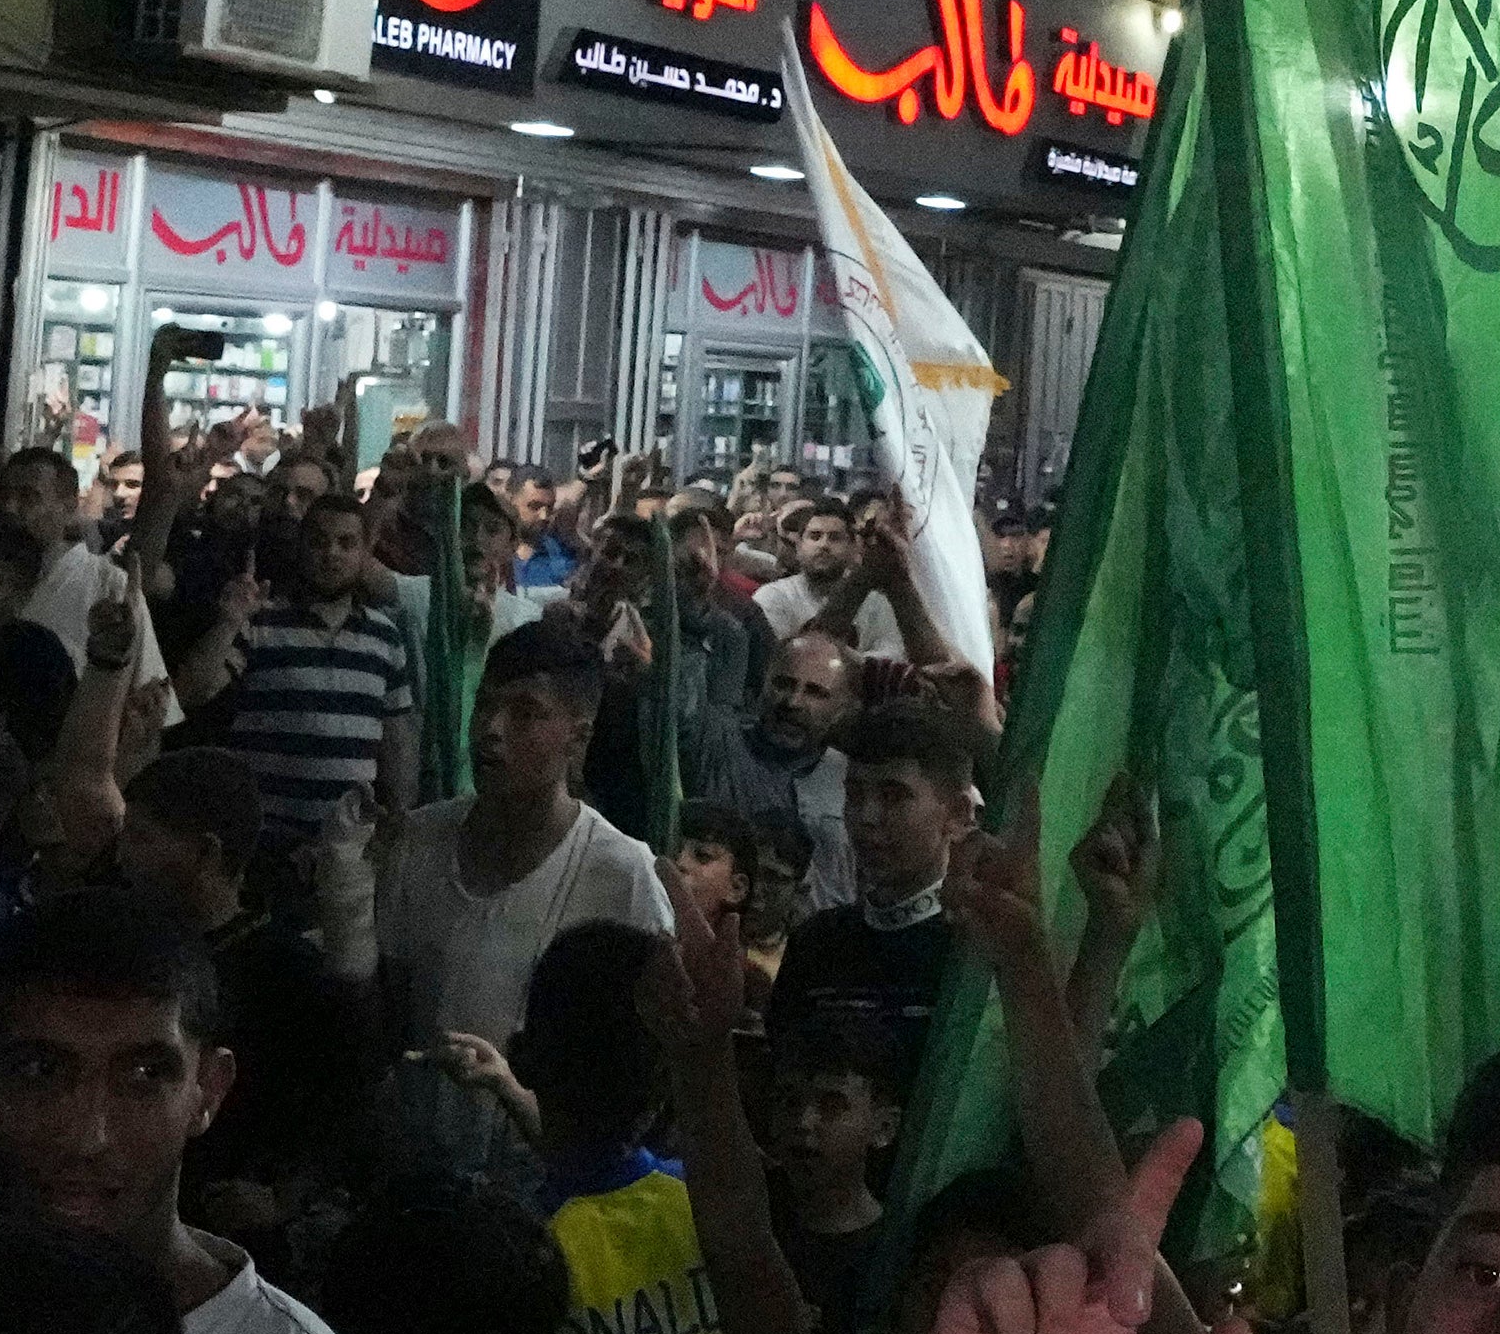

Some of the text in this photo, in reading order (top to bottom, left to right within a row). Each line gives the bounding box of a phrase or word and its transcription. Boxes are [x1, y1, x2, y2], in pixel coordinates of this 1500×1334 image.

[372, 14, 517, 71] LEB PHARMACY
[574, 40, 628, 76] طالب
[627, 54, 692, 91] حسين
[693, 68, 760, 105] محمد
[1052, 26, 1157, 126] صيدلية
[151, 183, 306, 267] طالب
[334, 206, 449, 275] صيدلية
